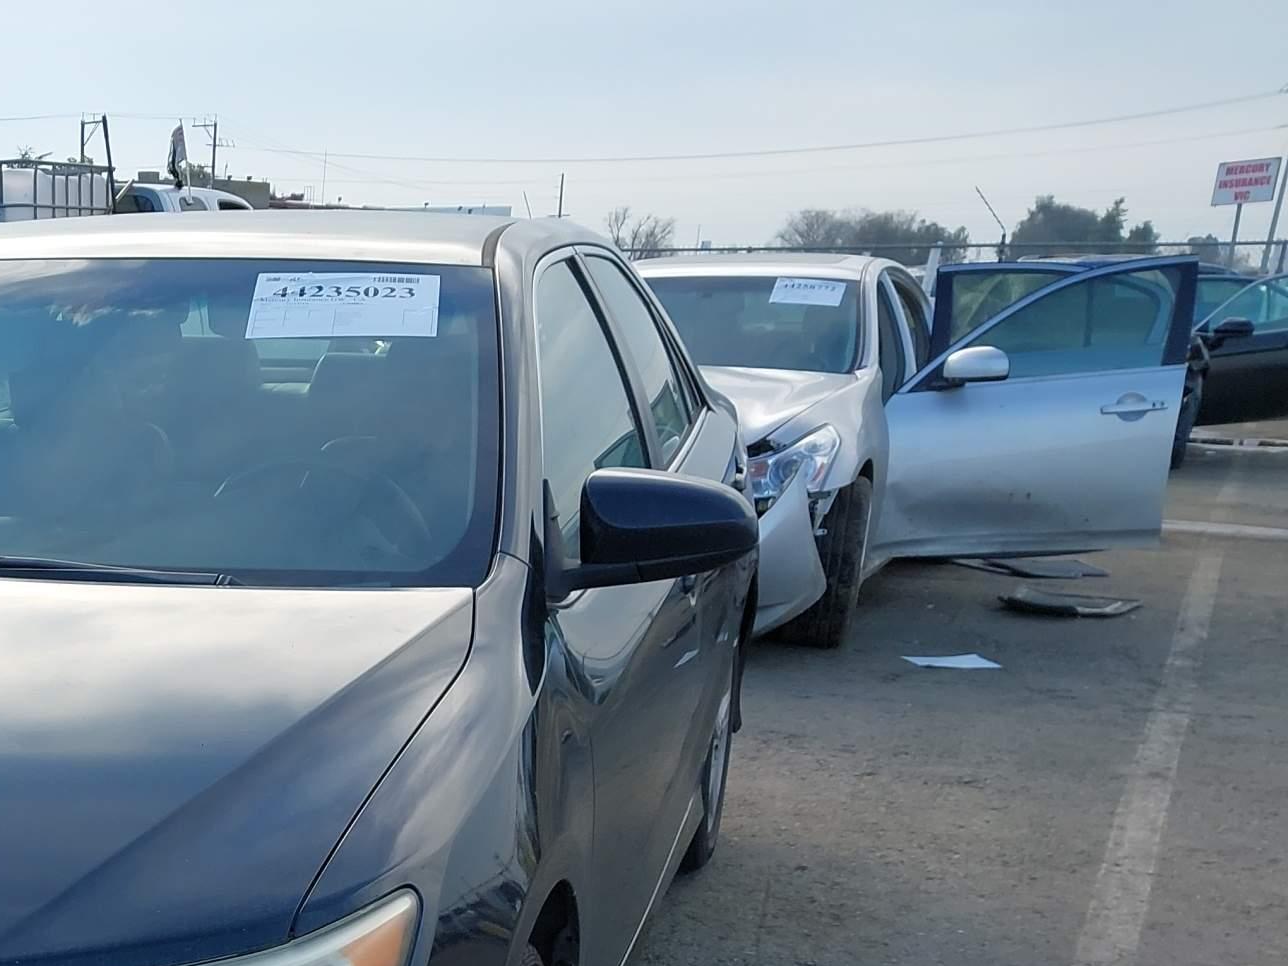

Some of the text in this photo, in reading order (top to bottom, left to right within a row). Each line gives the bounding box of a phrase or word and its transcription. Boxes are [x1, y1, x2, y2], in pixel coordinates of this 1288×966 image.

[1225, 163, 1272, 176] MERCURY
[1218, 176, 1272, 189] INSURANCE
[272, 285, 416, 299] 44235023
